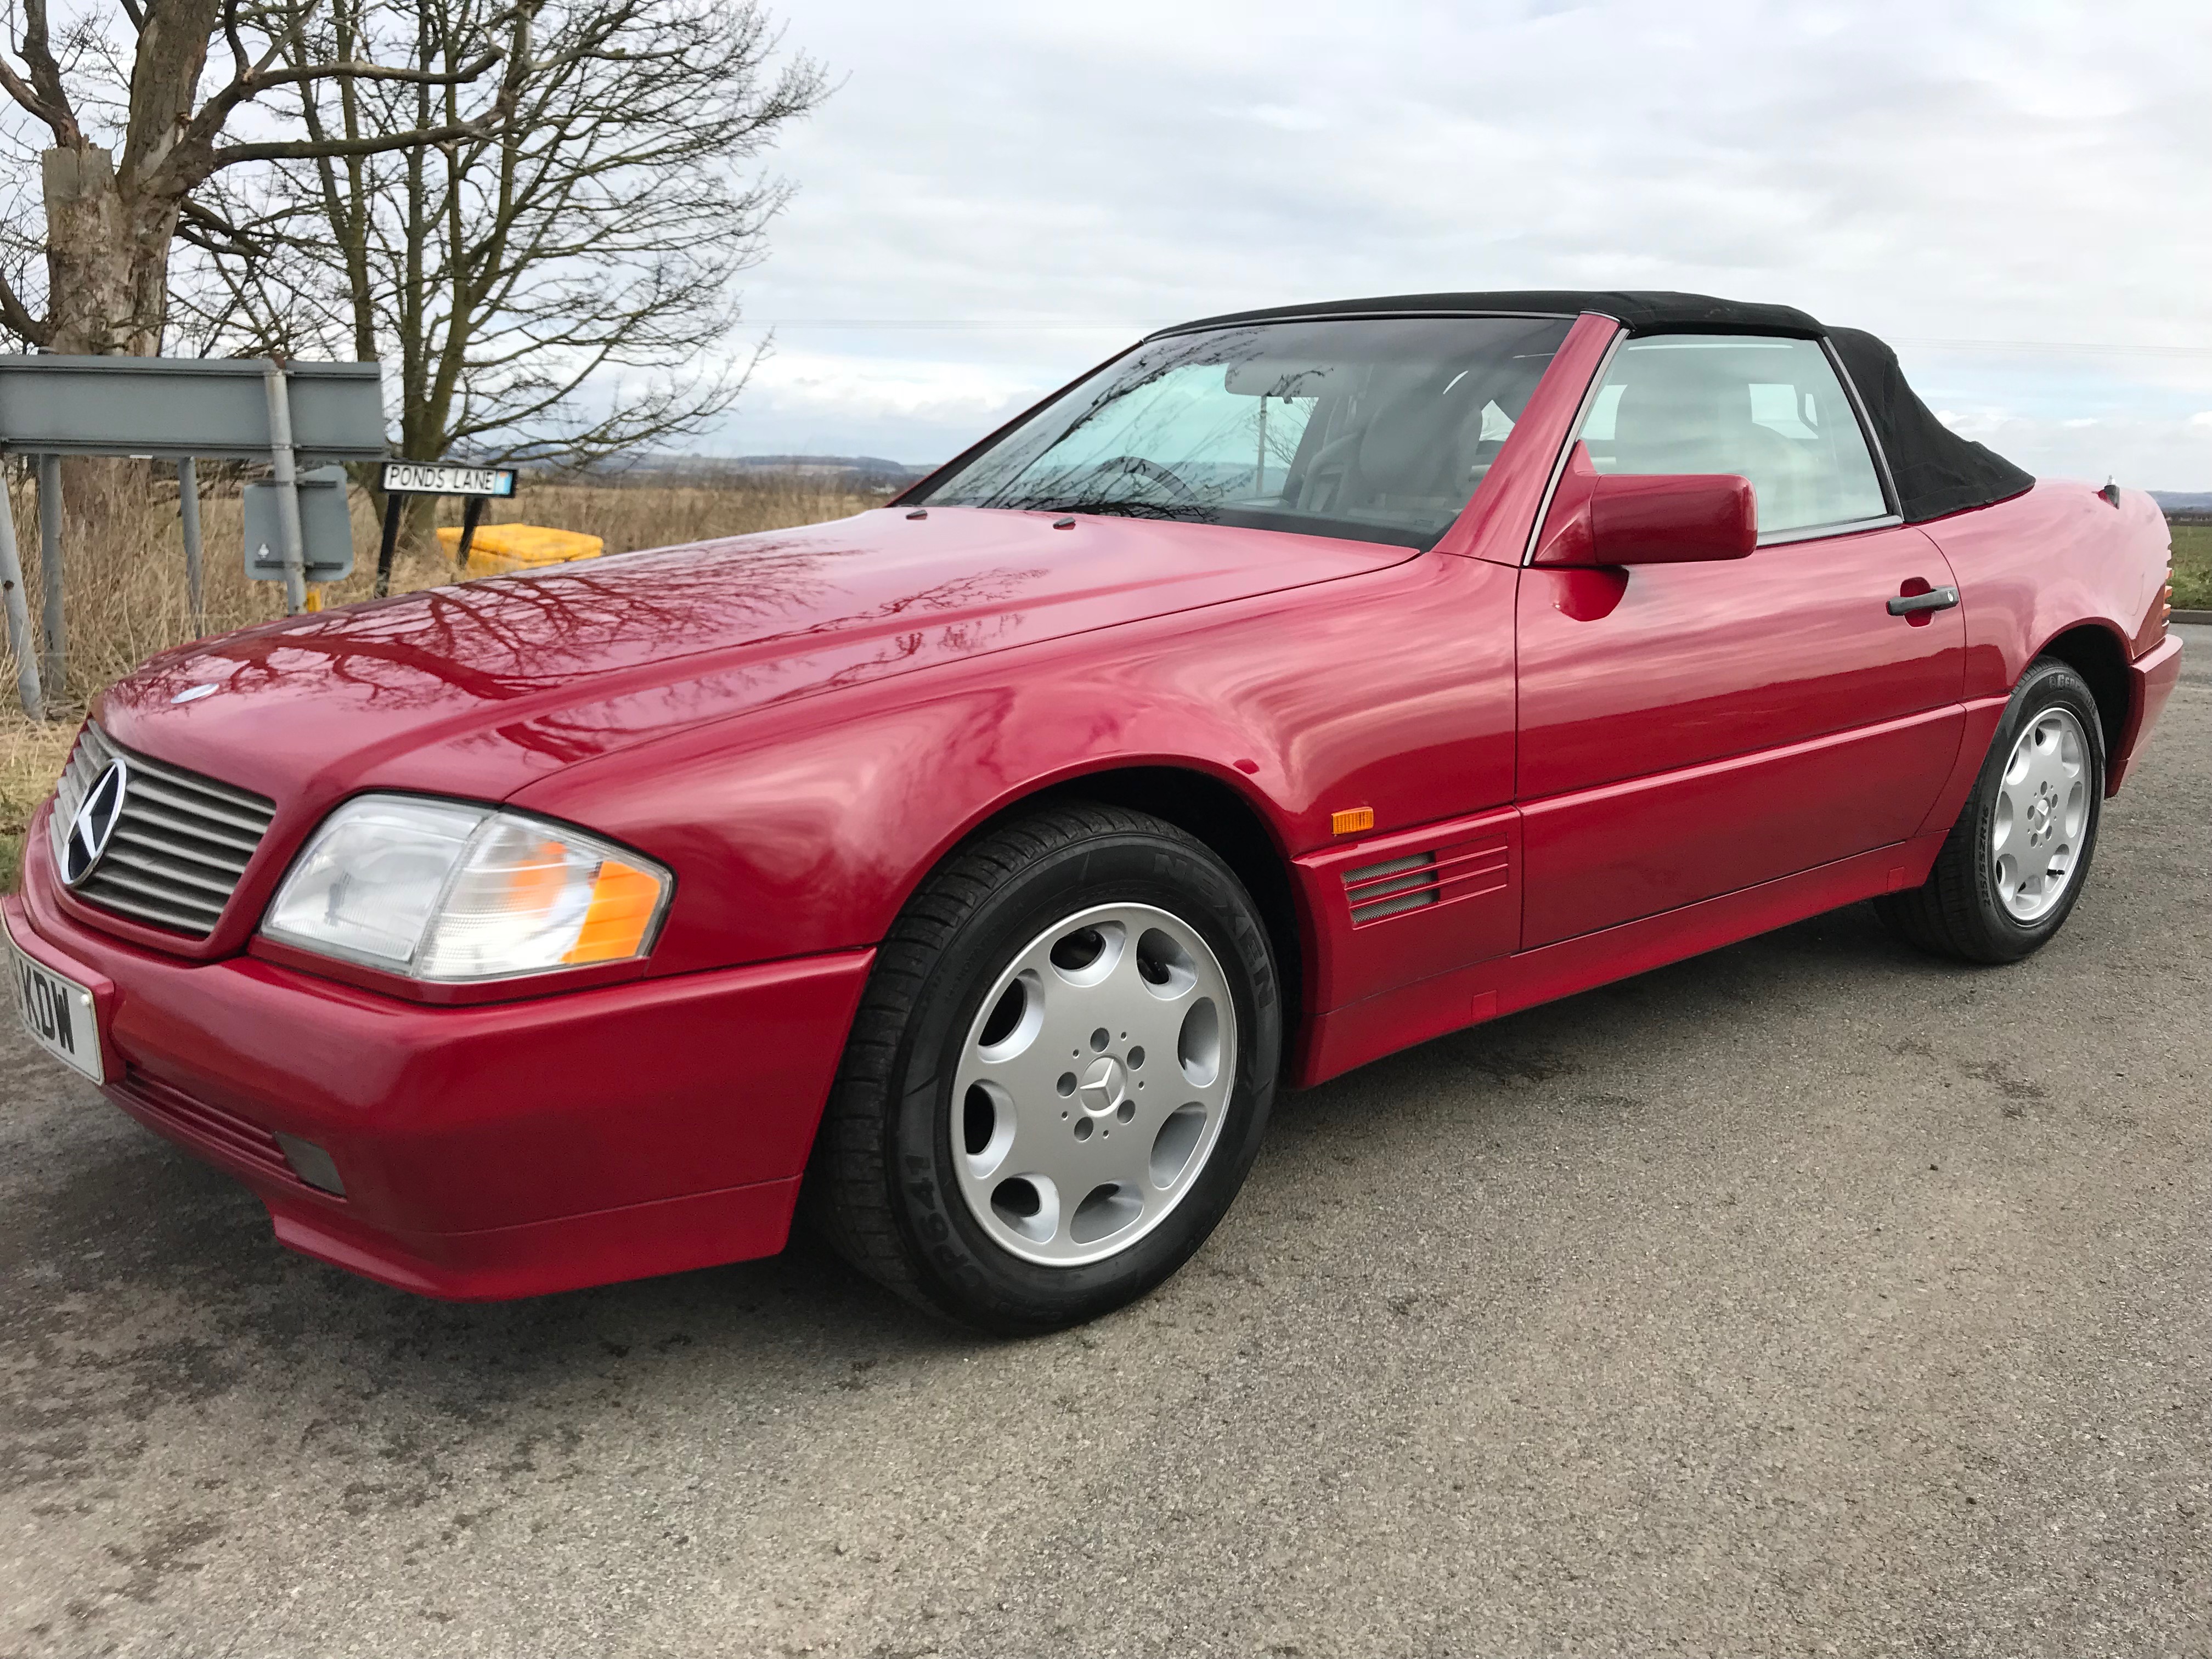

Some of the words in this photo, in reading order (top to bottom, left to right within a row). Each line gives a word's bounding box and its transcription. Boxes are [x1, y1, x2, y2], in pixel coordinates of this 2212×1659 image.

[389, 466, 444, 488] PONDS
[453, 469, 492, 490] LANE
[1153, 853, 1275, 1008] NEXEN
[19, 958, 75, 1054] KDW
